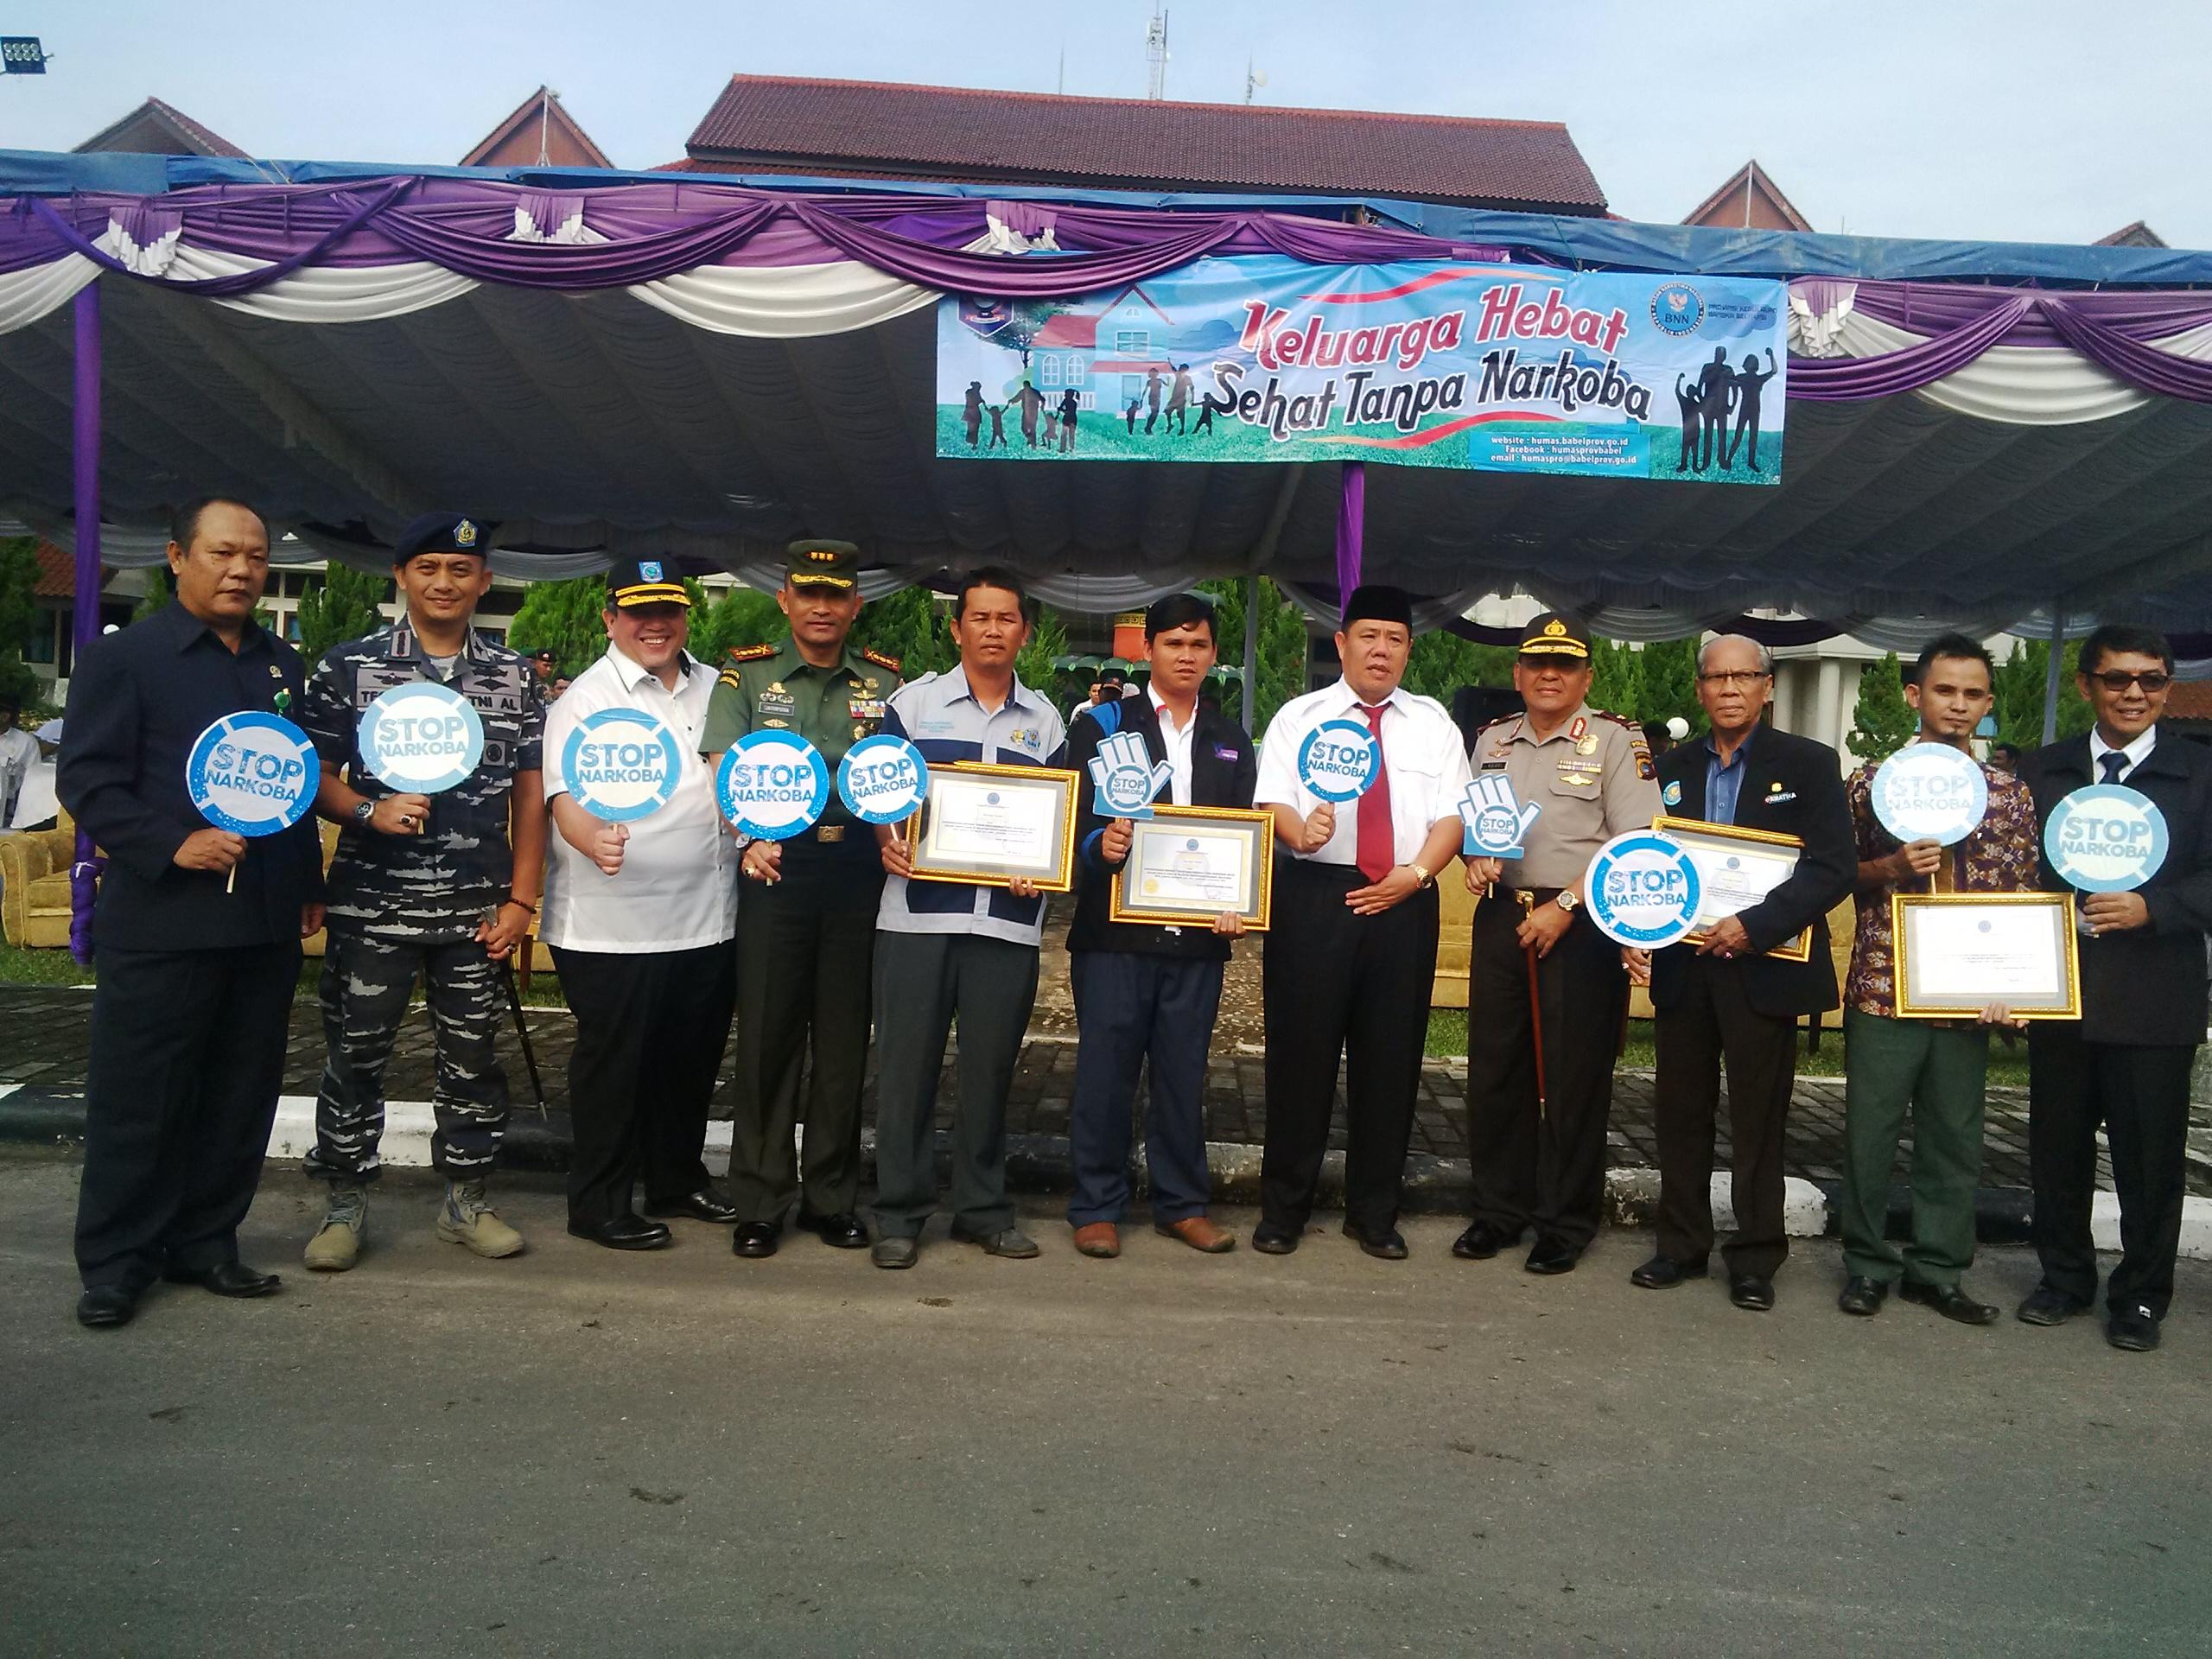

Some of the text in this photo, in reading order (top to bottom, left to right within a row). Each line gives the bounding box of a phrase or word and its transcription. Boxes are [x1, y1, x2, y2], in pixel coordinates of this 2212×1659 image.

[1240, 284, 1630, 371] Keluarga Hebat
[1664, 313, 1689, 324] BNN
[1213, 347, 1652, 442] Sehat Tanpa Narkoba
[1491, 436, 1525, 445] website
[1531, 436, 1629, 447] humas.babelprov.go.id
[1491, 454, 1515, 462] email
[1552, 446, 1622, 457] humasprovbabel
[467, 695, 518, 711] TNI AL
[378, 716, 464, 742] STOP
[378, 742, 467, 758] NARKOBA
[581, 742, 663, 768] STOP
[1311, 741, 1370, 766] STOP
[213, 743, 304, 784] STOP
[851, 758, 912, 787] STOP
[1307, 759, 1369, 780] NARKOBA
[578, 767, 664, 784] NARKOBA
[733, 764, 812, 788] STOP
[1112, 777, 1146, 791] STOP
[204, 768, 298, 804] NARKOBA
[732, 787, 812, 804] NARKOBA
[851, 778, 918, 799] NARKOBA
[1111, 786, 1146, 797] NARKOBA
[1890, 774, 1970, 798] STOP
[1887, 797, 1972, 812] NARKOBA
[1482, 817, 1514, 830] STOP
[2064, 816, 2151, 842] STOP
[2060, 841, 2149, 859] NARKOBA
[1608, 868, 1683, 893] STOP
[1605, 893, 1686, 907] NARKOBA
